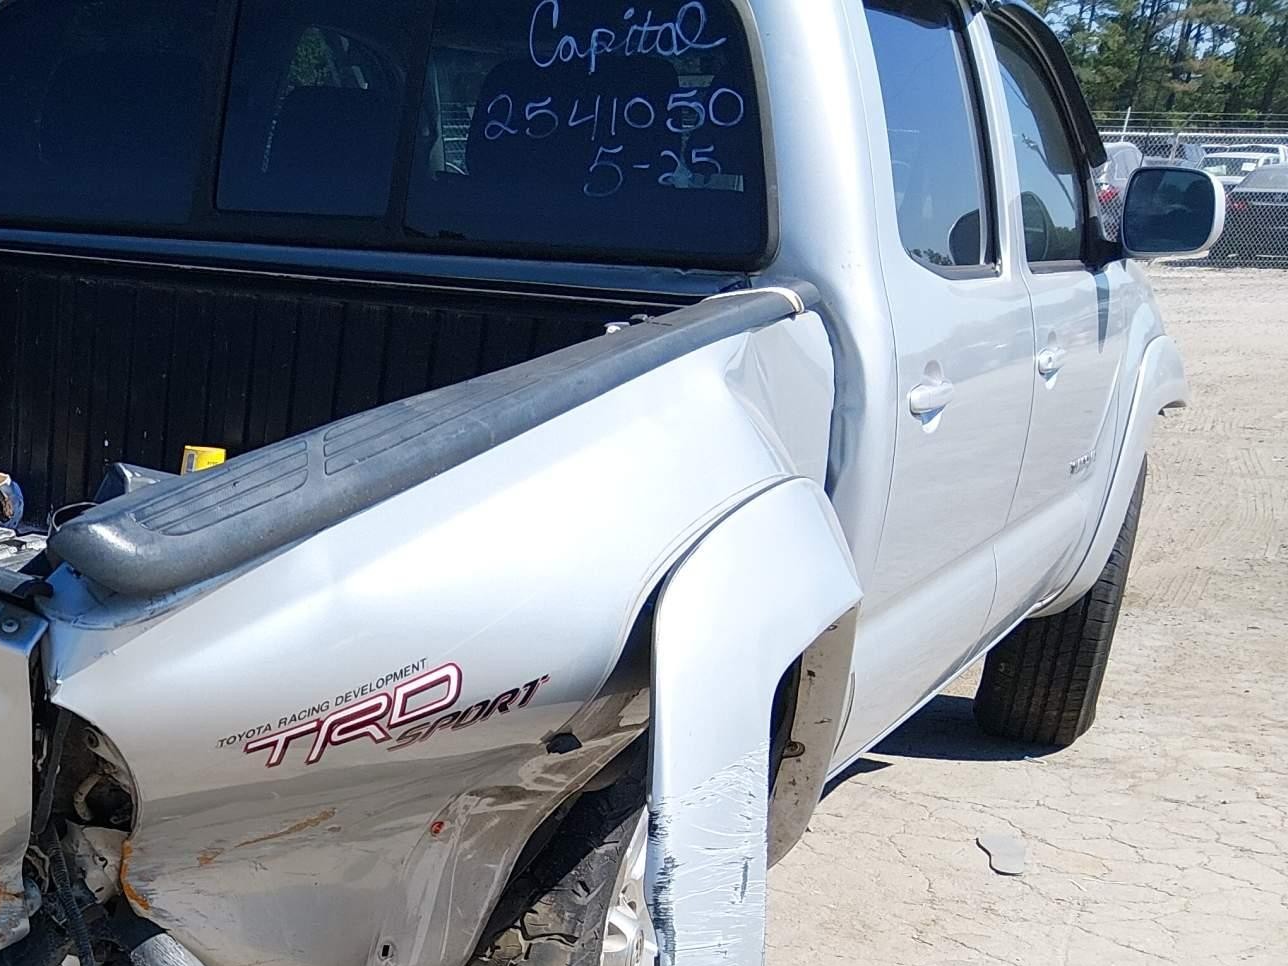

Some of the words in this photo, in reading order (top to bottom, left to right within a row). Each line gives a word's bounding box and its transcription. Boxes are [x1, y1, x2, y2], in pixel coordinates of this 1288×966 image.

[217, 723, 273, 749] TOYOTA
[277, 700, 330, 730] RACING
[334, 658, 428, 708] DEVELOPMENT
[243, 661, 464, 768] TRD
[387, 674, 551, 751] SPORT
